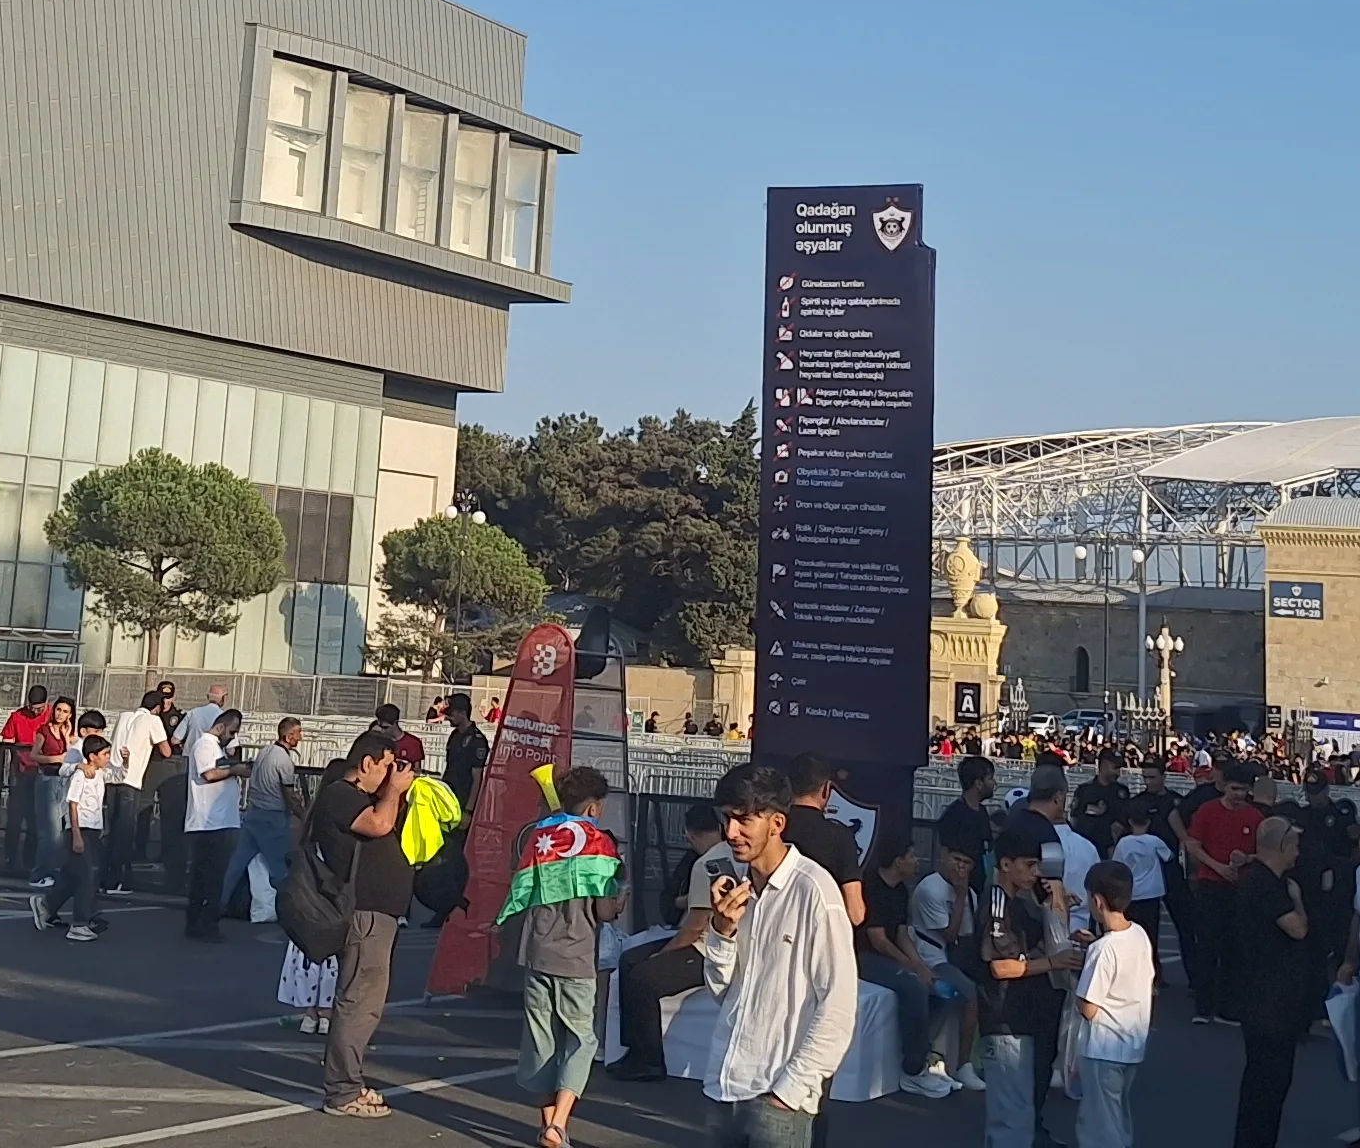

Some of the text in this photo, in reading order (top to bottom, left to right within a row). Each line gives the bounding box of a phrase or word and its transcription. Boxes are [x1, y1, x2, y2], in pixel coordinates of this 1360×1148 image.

[796, 203, 856, 218] Qadağan
[796, 221, 852, 237] olunmuş
[796, 240, 843, 254] əşyalar
[830, 468, 839, 477] 30
[1273, 597, 1321, 609] SECTOR
[962, 695, 974, 712] A
[504, 715, 560, 735] Məlumat
